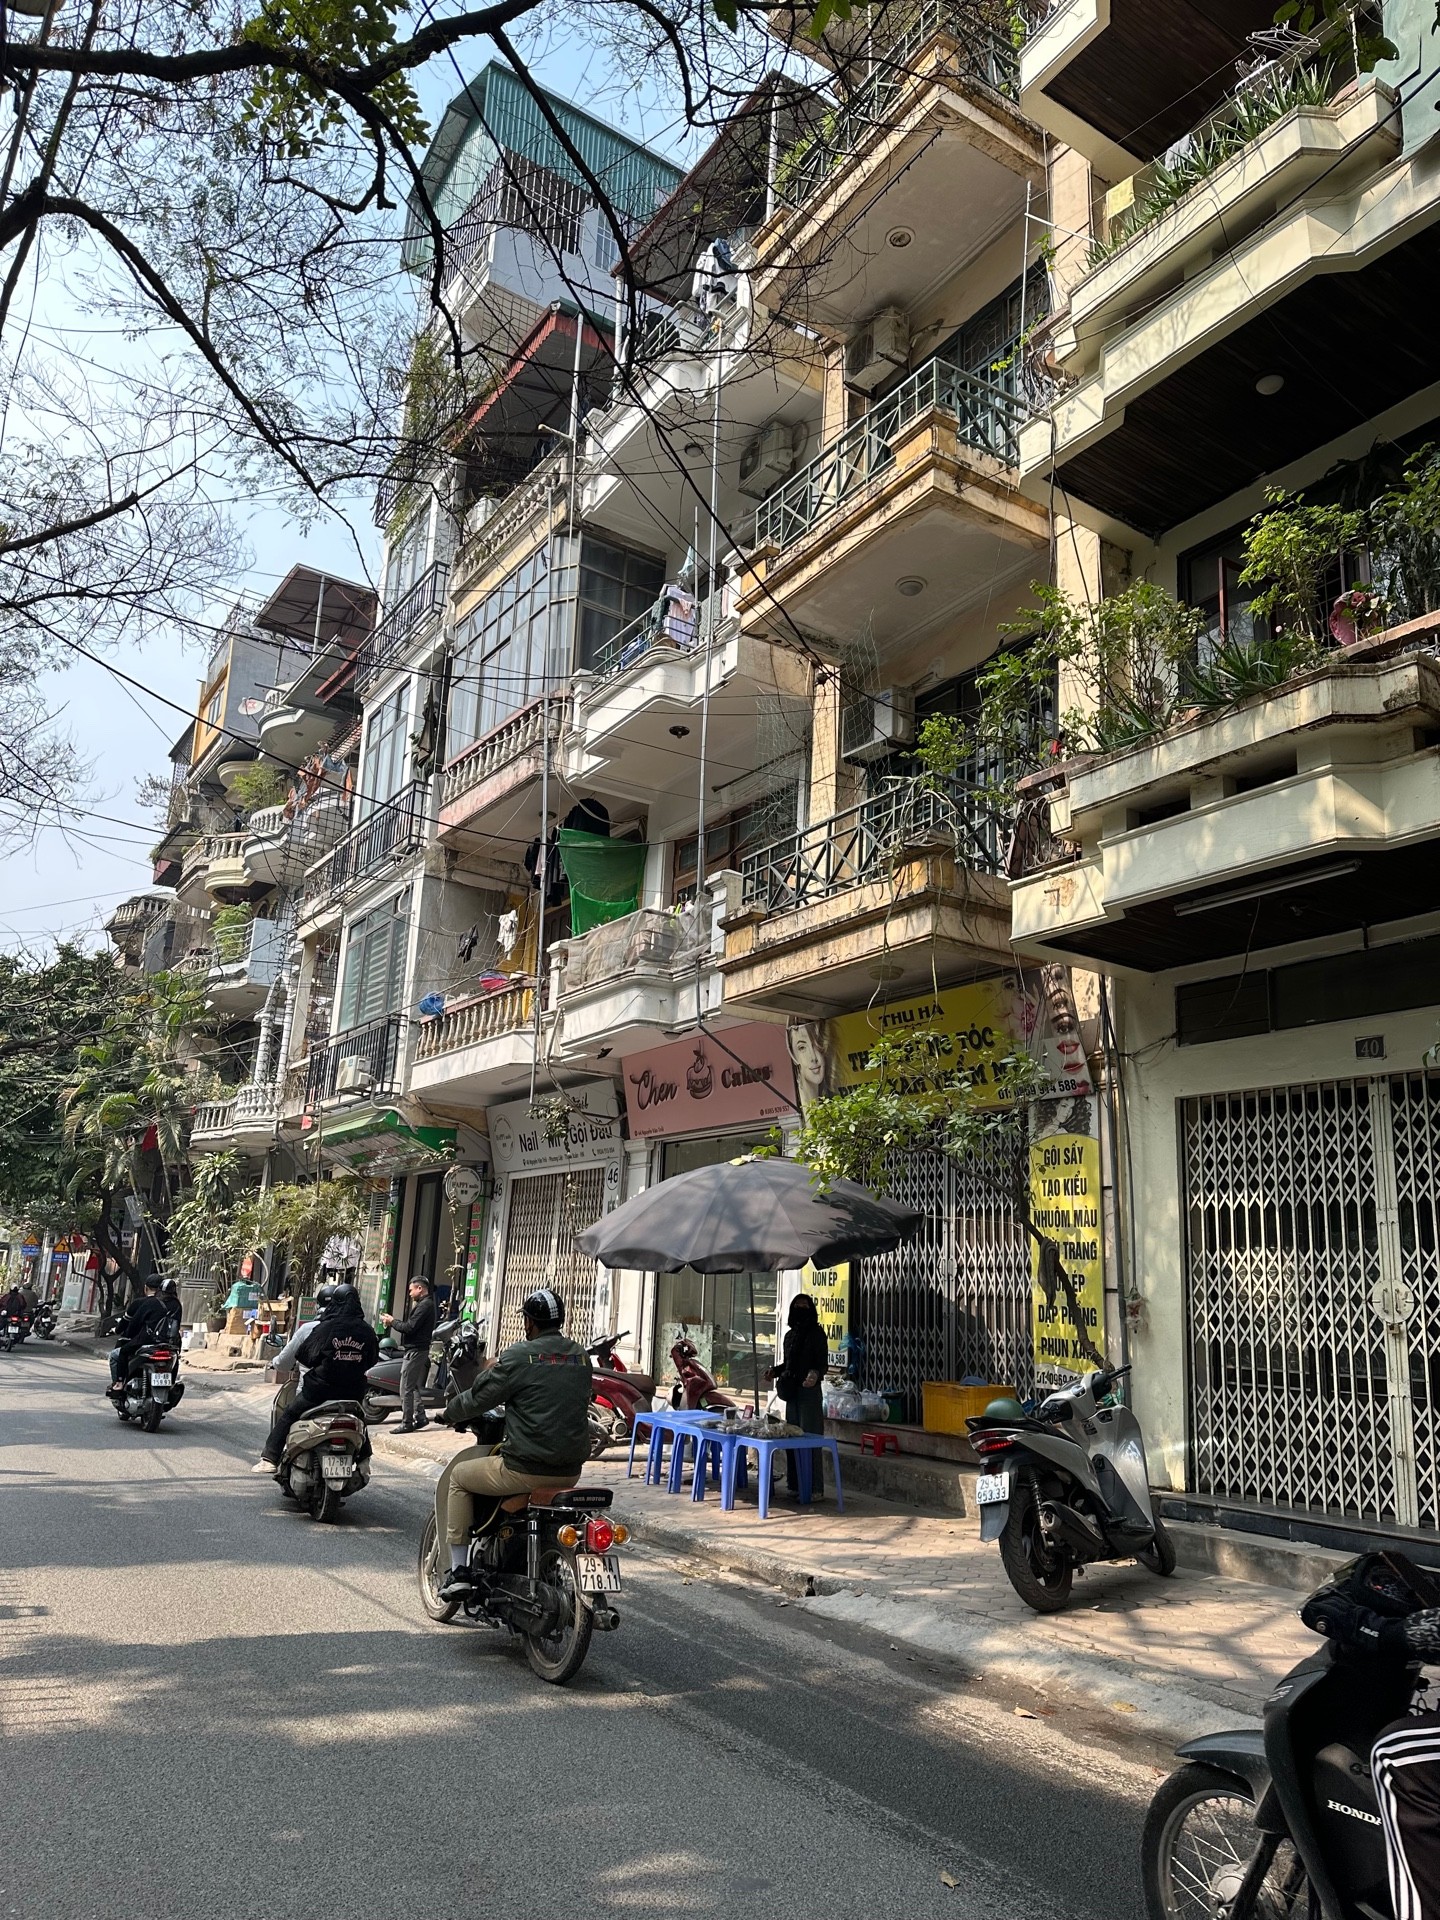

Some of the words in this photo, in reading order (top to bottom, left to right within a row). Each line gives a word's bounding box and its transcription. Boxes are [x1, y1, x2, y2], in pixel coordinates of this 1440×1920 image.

[878, 1009, 915, 1027] THU
[917, 1000, 945, 1020] HÀ
[955, 1022, 996, 1051] TÓC
[1361, 1039, 1379, 1056] 40
[629, 1070, 679, 1111] Chen
[1058, 1079, 1077, 1092] 588
[518, 1130, 539, 1153] Nail
[569, 1121, 588, 1148] Gội
[590, 1117, 613, 1141] Đầu
[1043, 1144, 1060, 1170] GỘI
[1063, 1140, 1084, 1165] SẤY
[607, 1168, 619, 1184] 46
[1041, 1178, 1060, 1201] TẠO
[1063, 1170, 1087, 1197] KIỂU
[1033, 1206, 1070, 1232] NHUỘM
[1073, 1205, 1097, 1228] MÀU
[1063, 1241, 1098, 1260] TRANG
[828, 1268, 838, 1287] ÉP
[1061, 1300, 1098, 1327] PHNG
[332, 1336, 365, 1350] Portland
[1040, 1336, 1069, 1358] PHUN
[333, 1350, 362, 1362] Academy
[979, 1474, 1003, 1490] 29-C1
[977, 1488, 1006, 1503] 953.33
[583, 1557, 614, 1573] 29-AA
[581, 1574, 619, 1590] 718.11
